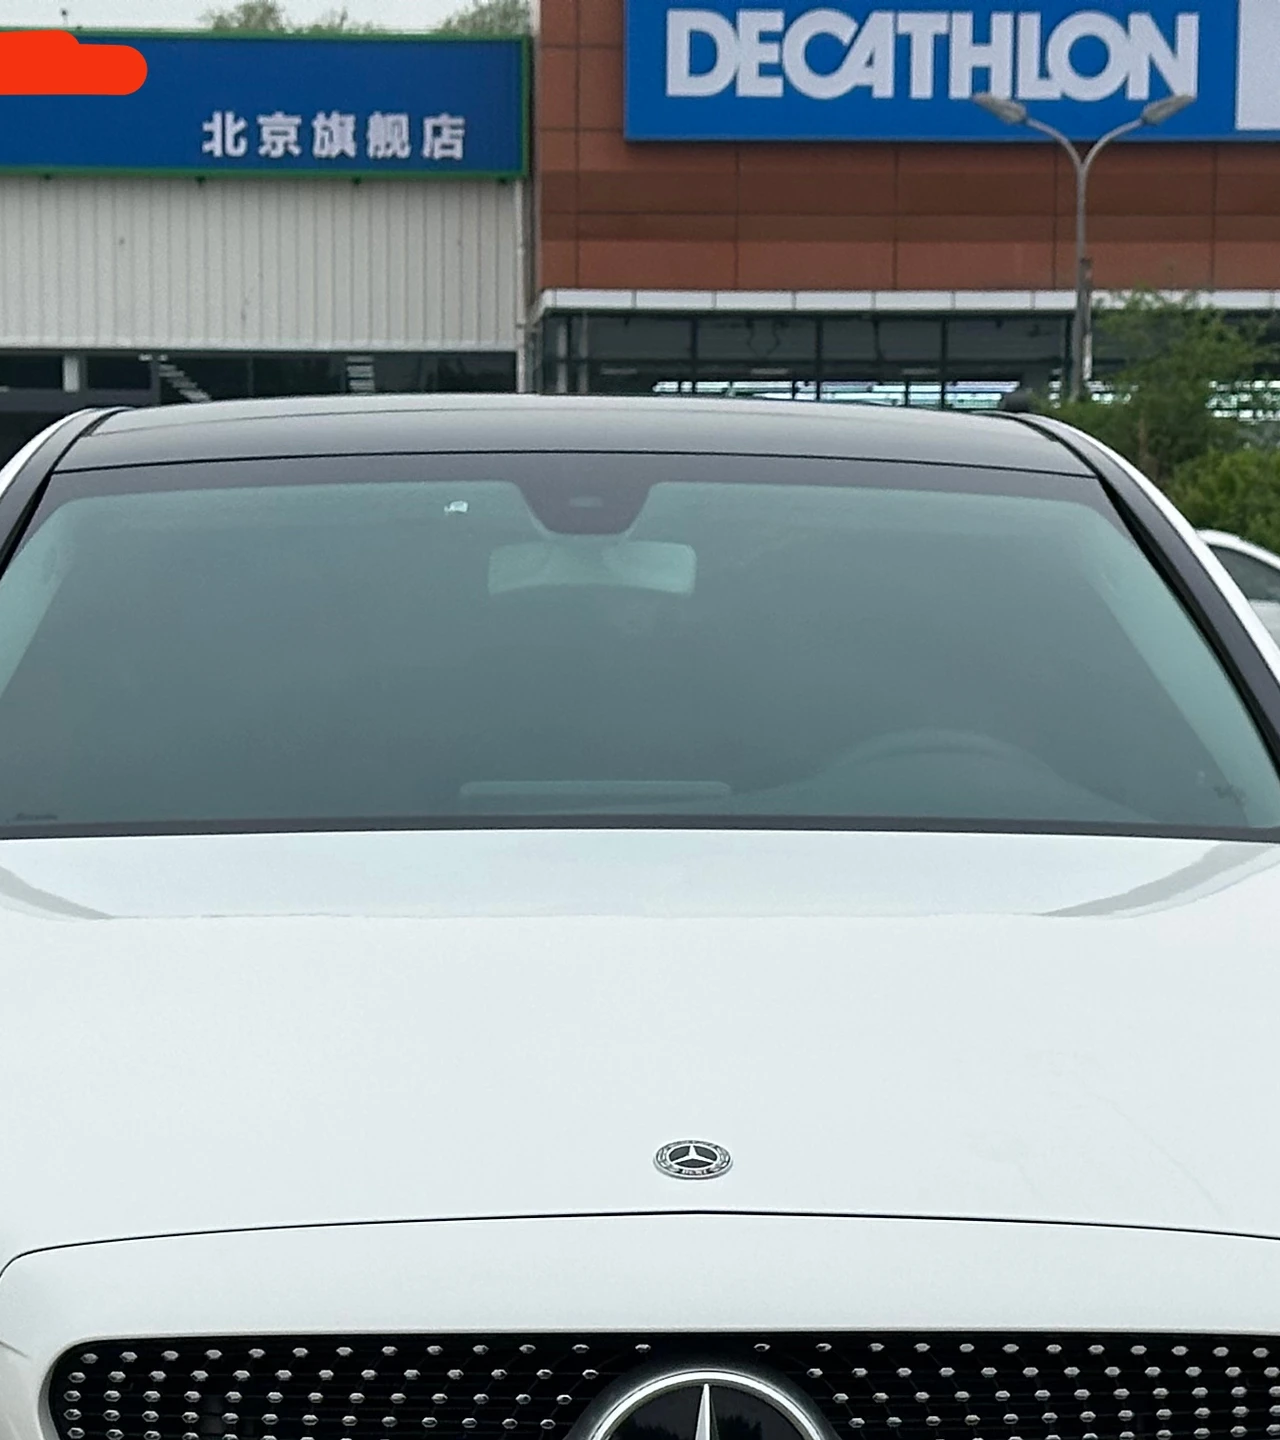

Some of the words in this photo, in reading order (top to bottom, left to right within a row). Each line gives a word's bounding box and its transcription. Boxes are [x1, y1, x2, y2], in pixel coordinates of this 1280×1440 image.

[665, 8, 1200, 101] DECATHLON
[202, 110, 465, 159] 北京旗舰店
